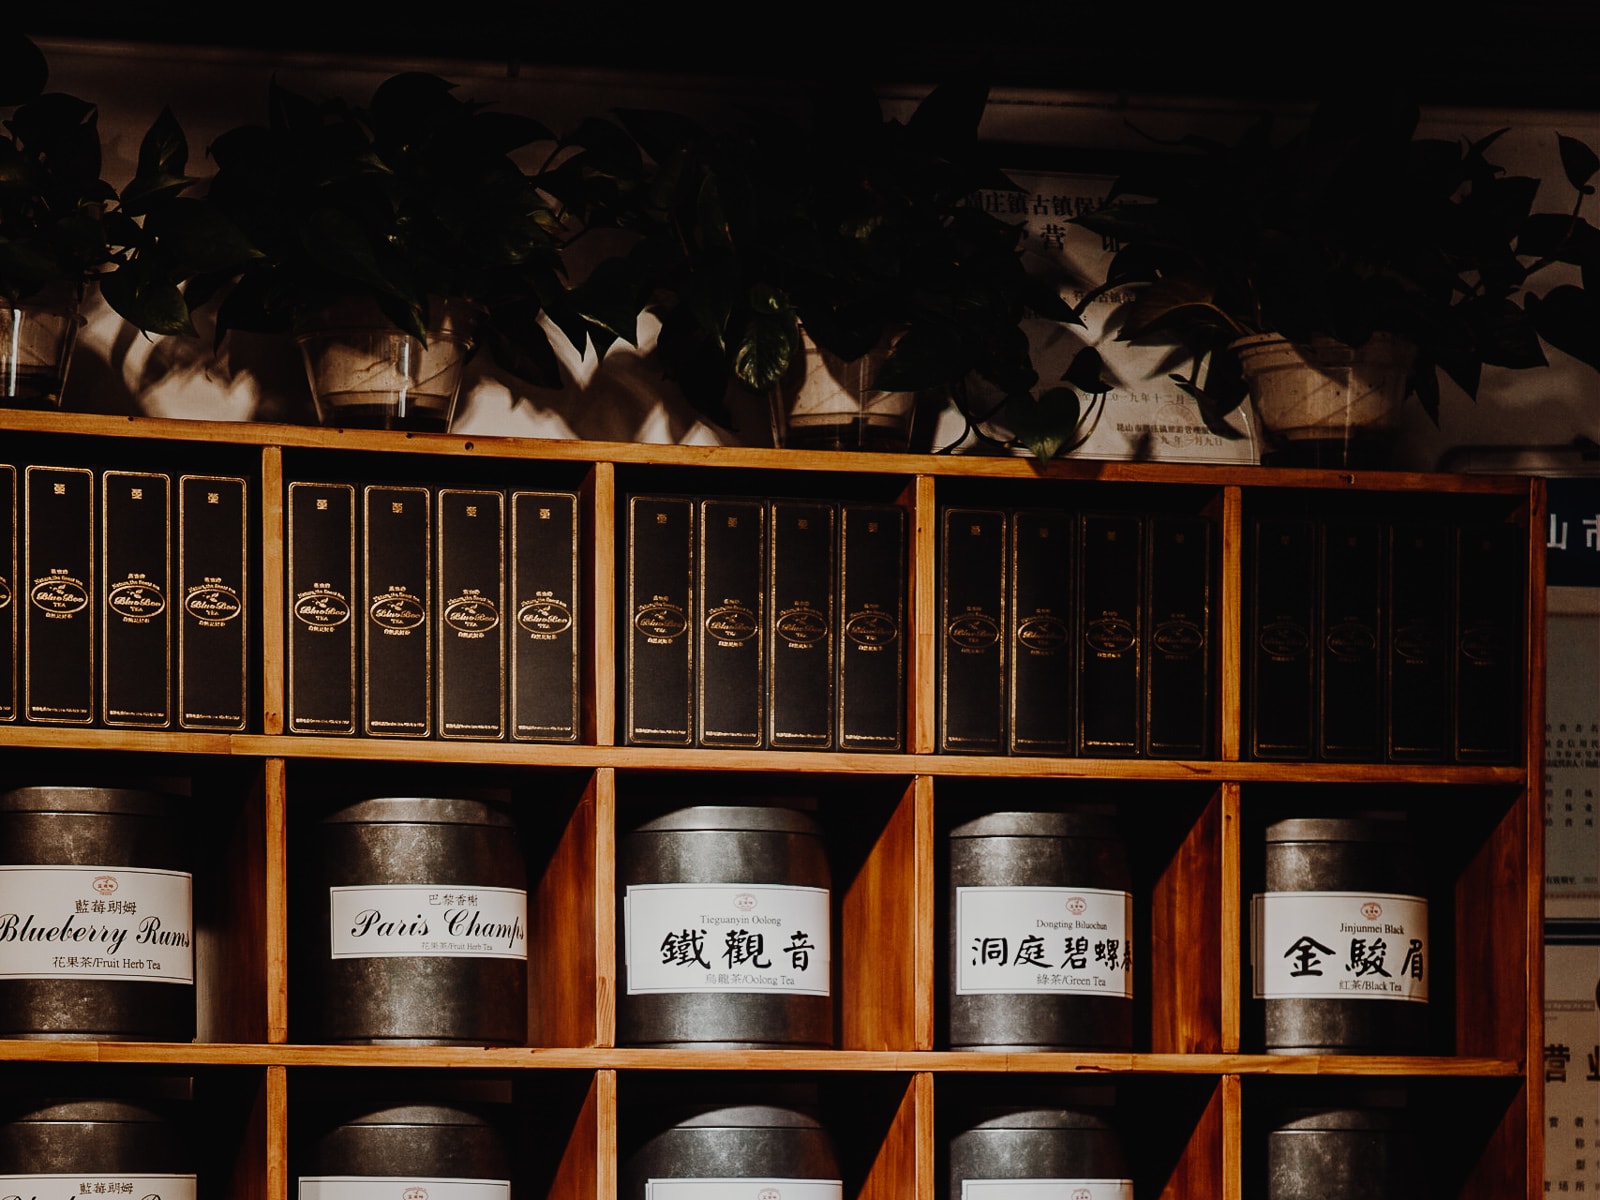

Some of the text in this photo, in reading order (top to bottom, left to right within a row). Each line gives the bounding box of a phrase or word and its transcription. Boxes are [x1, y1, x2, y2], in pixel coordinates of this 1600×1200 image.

[700, 915, 782, 926] Tieguanyin Oolong
[1036, 919, 1073, 930] Dongting
[0, 913, 190, 955] Blueberry Rums
[351, 908, 524, 948] Paris Champs
[1339, 922, 1405, 935] Jinjunmei Black
[660, 929, 815, 971] 鐵觀音
[52, 956, 161, 970] 花果茶/Fruit Herb Tea
[1283, 935, 1424, 982] 金駿眉
[780, 975, 795, 985] Tea
